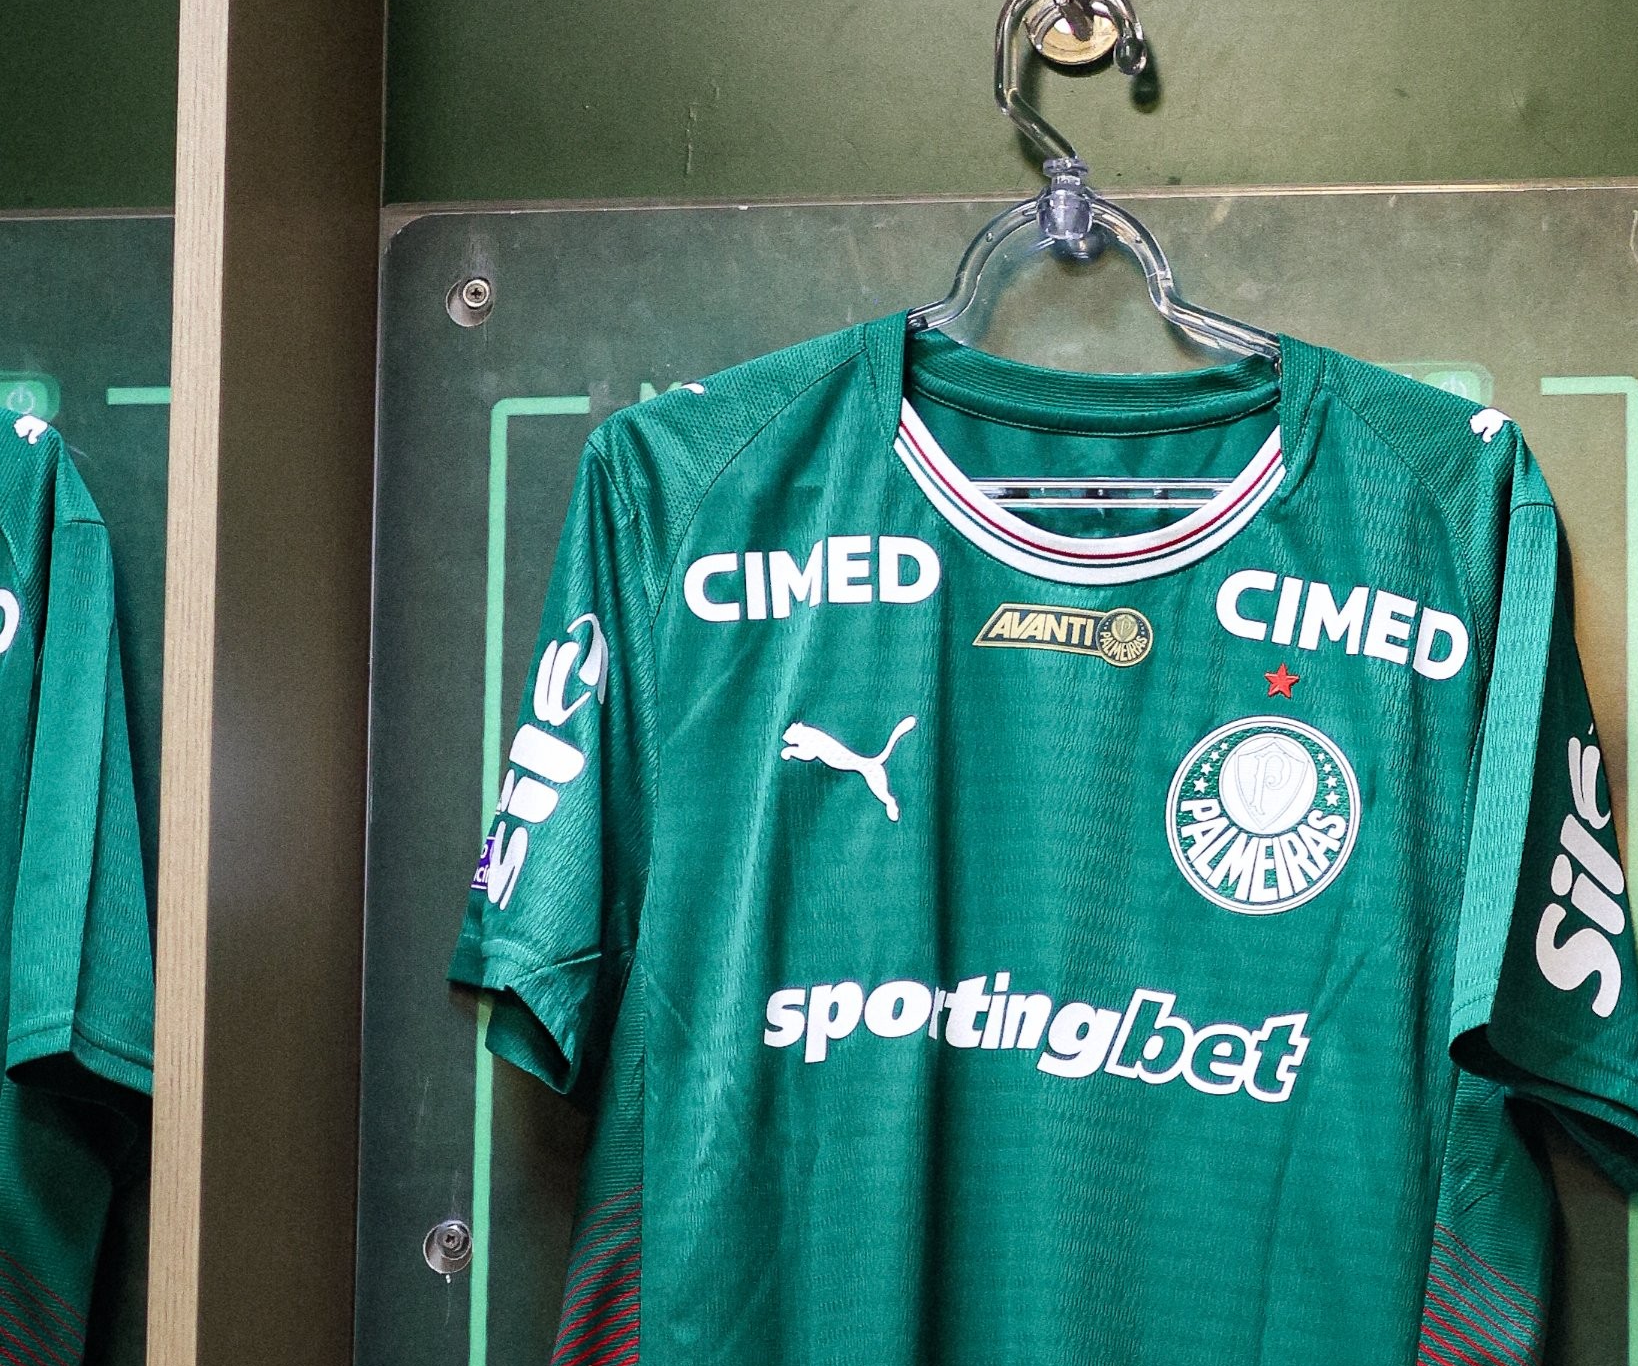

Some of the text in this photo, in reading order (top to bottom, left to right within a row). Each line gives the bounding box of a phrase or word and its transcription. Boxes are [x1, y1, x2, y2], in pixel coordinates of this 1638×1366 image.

[683, 534, 942, 624] CIMED
[1216, 569, 1470, 682] CIMED
[987, 611, 1095, 647] AVANTI
[1099, 630, 1148, 662] PALMEIRAS
[1179, 797, 1348, 902] PALMEIRAS
[763, 971, 1310, 1104] sportingbet
